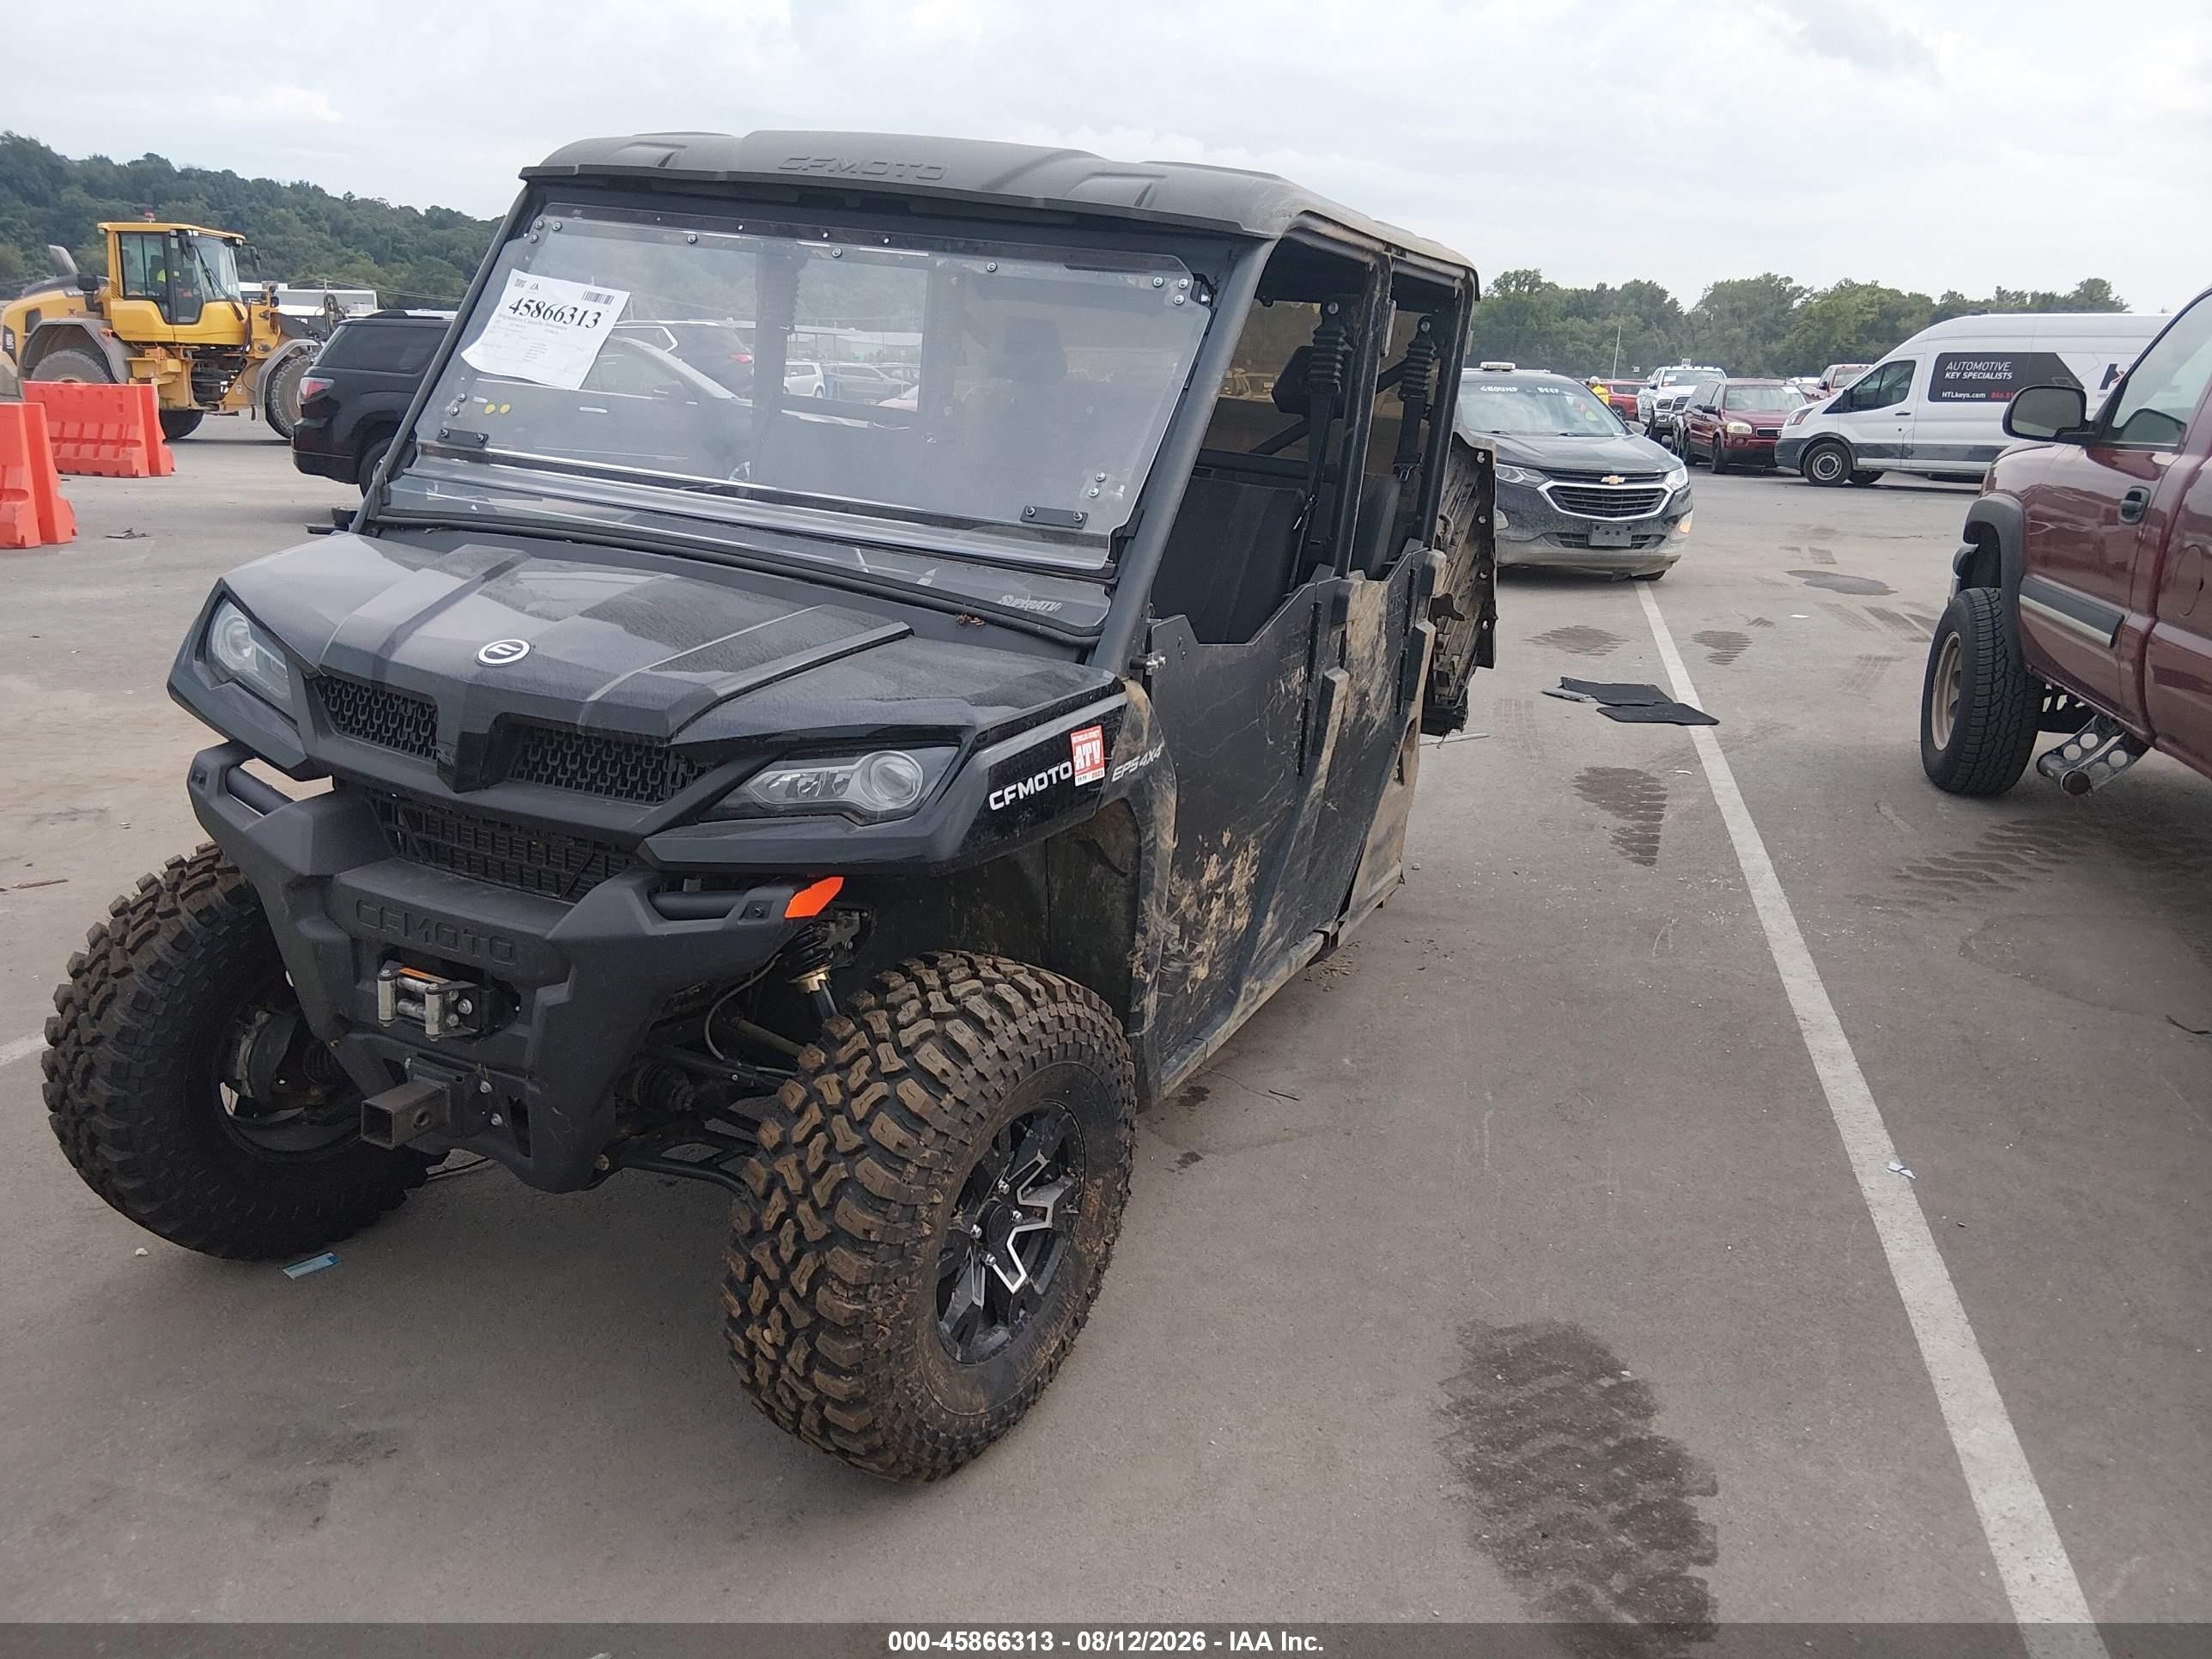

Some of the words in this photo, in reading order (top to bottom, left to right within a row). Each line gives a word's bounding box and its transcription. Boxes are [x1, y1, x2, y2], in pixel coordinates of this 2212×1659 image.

[777, 156, 951, 180] CFMOTO
[508, 297, 602, 329] 45866313
[1944, 362, 2012, 372] AUTOMOTIVE
[1962, 372, 2014, 380] SPECIALISTS
[1942, 391, 1986, 399] HTLkeys.com
[1073, 739, 1101, 770] ATV
[988, 761, 1073, 811] CFMOTO
[356, 899, 516, 966] CFMOTO
